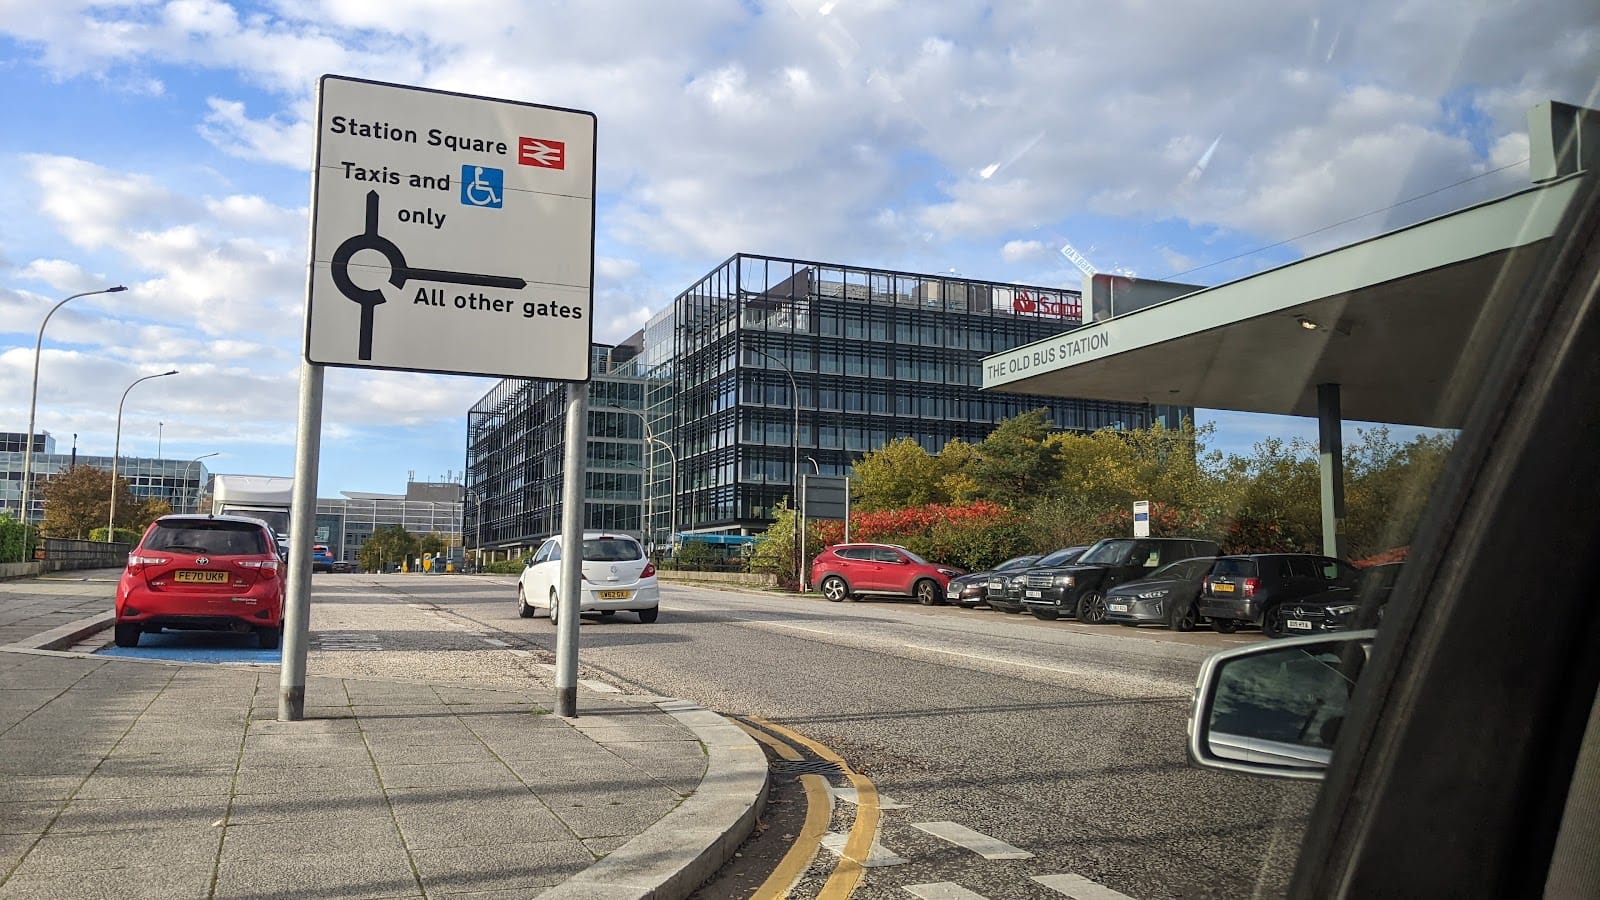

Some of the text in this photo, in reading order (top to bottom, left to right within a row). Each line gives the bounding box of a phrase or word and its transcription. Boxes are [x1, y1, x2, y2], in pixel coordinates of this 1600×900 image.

[330, 116, 508, 155] Station Square
[341, 161, 450, 191] Taxis and
[398, 208, 446, 229] only
[413, 287, 582, 320] All other gates
[987, 331, 1109, 379] THE OLD BUS STATION
[179, 571, 224, 582] FE70 UKR
